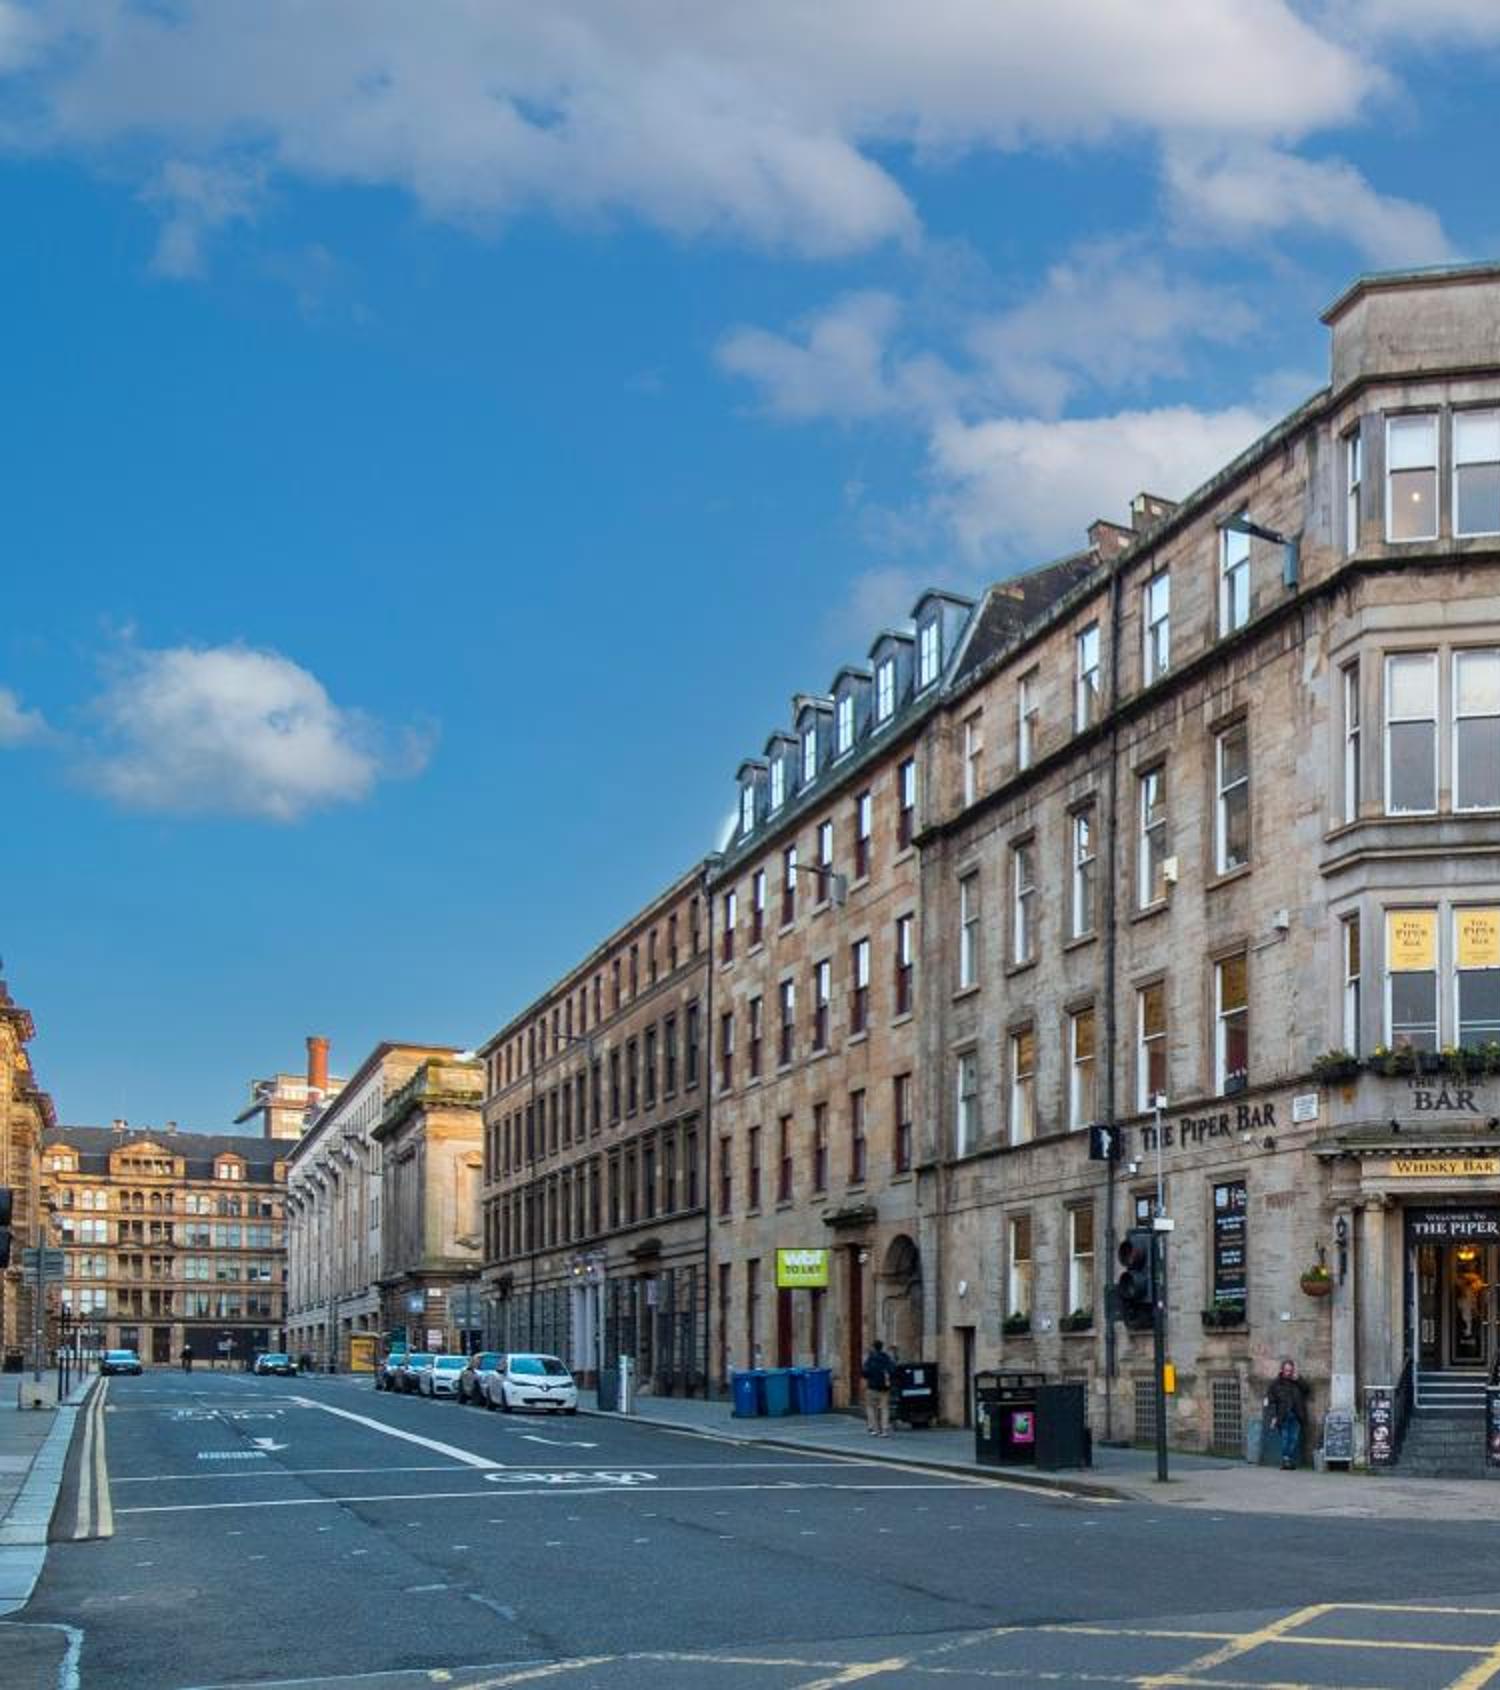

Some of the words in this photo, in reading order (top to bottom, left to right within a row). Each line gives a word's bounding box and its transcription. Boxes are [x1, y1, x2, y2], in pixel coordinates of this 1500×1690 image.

[1413, 1090, 1479, 1112] BAR
[1140, 1125, 1173, 1151] THE
[1180, 1113, 1231, 1148] PIPER
[1237, 1104, 1276, 1131] BAR
[1412, 1222, 1447, 1234] THE
[1450, 1221, 1500, 1235] PIPER
[785, 1265, 799, 1274] TO
[801, 1264, 821, 1274] LET
